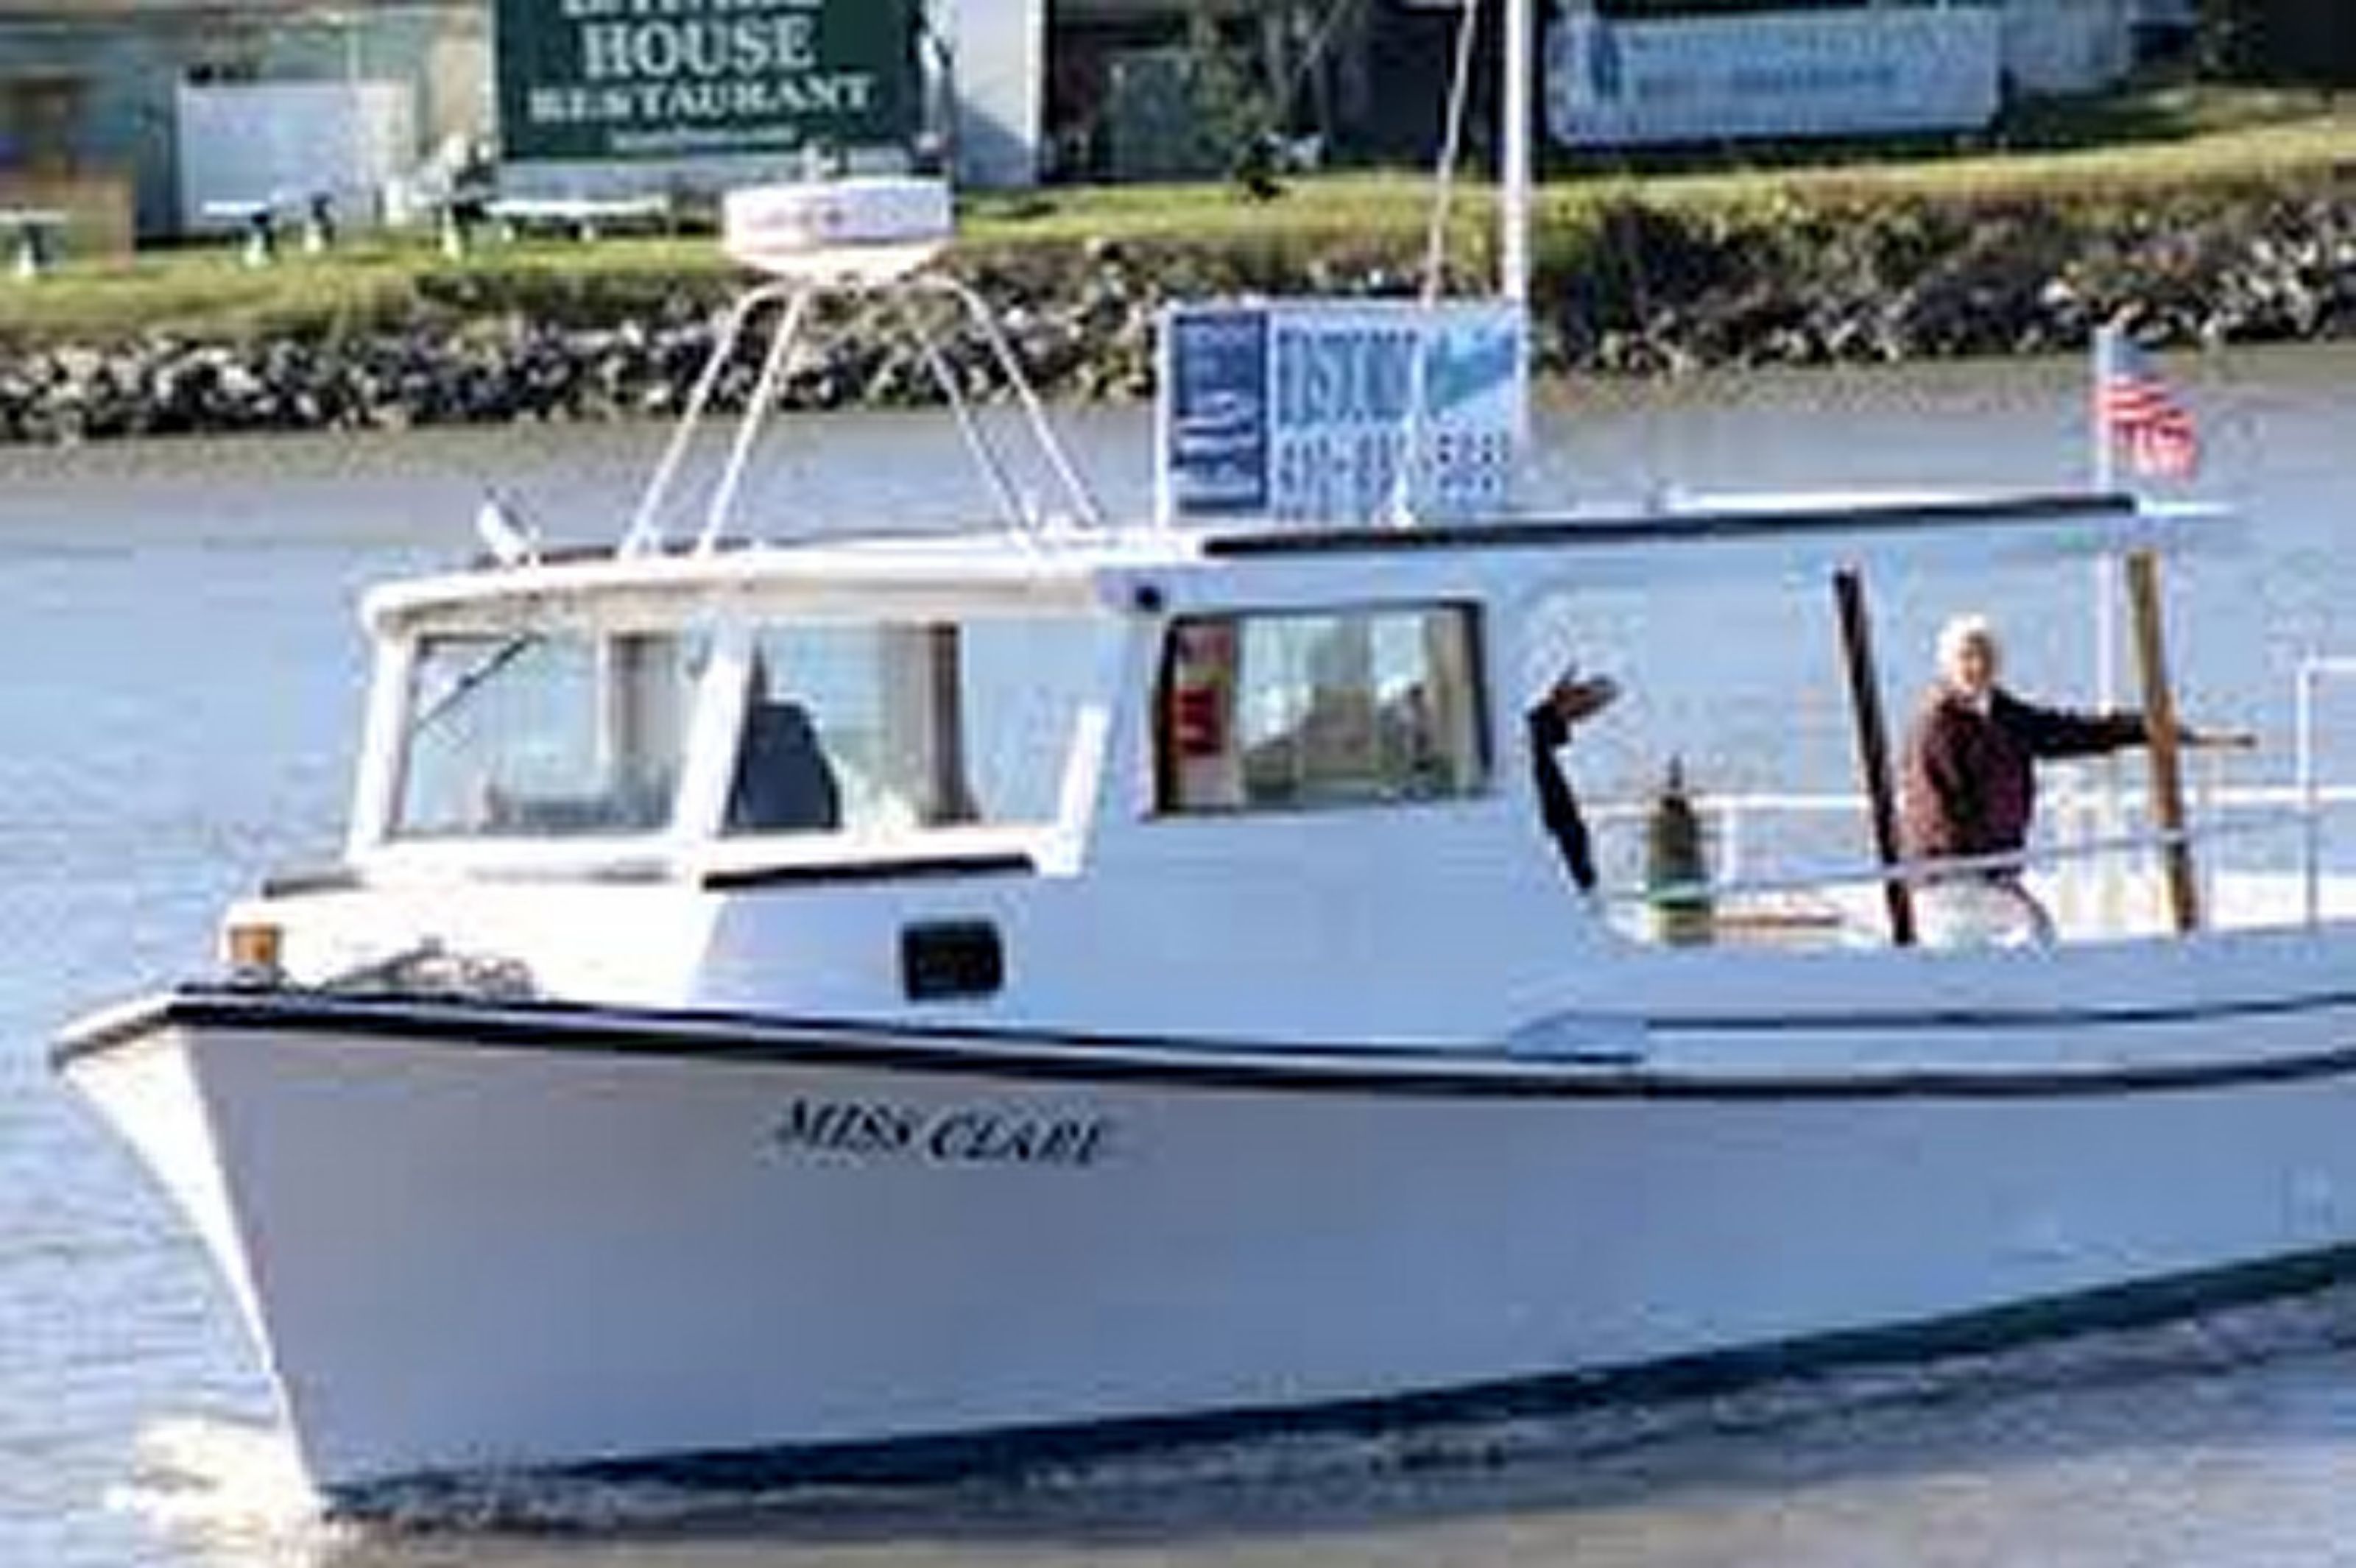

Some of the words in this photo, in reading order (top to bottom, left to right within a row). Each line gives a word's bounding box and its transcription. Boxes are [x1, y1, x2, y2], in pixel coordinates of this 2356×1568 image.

[584, 15, 816, 79] HOUSE
[529, 72, 875, 122] RESTAURANT
[775, 1099, 914, 1151] MISS
